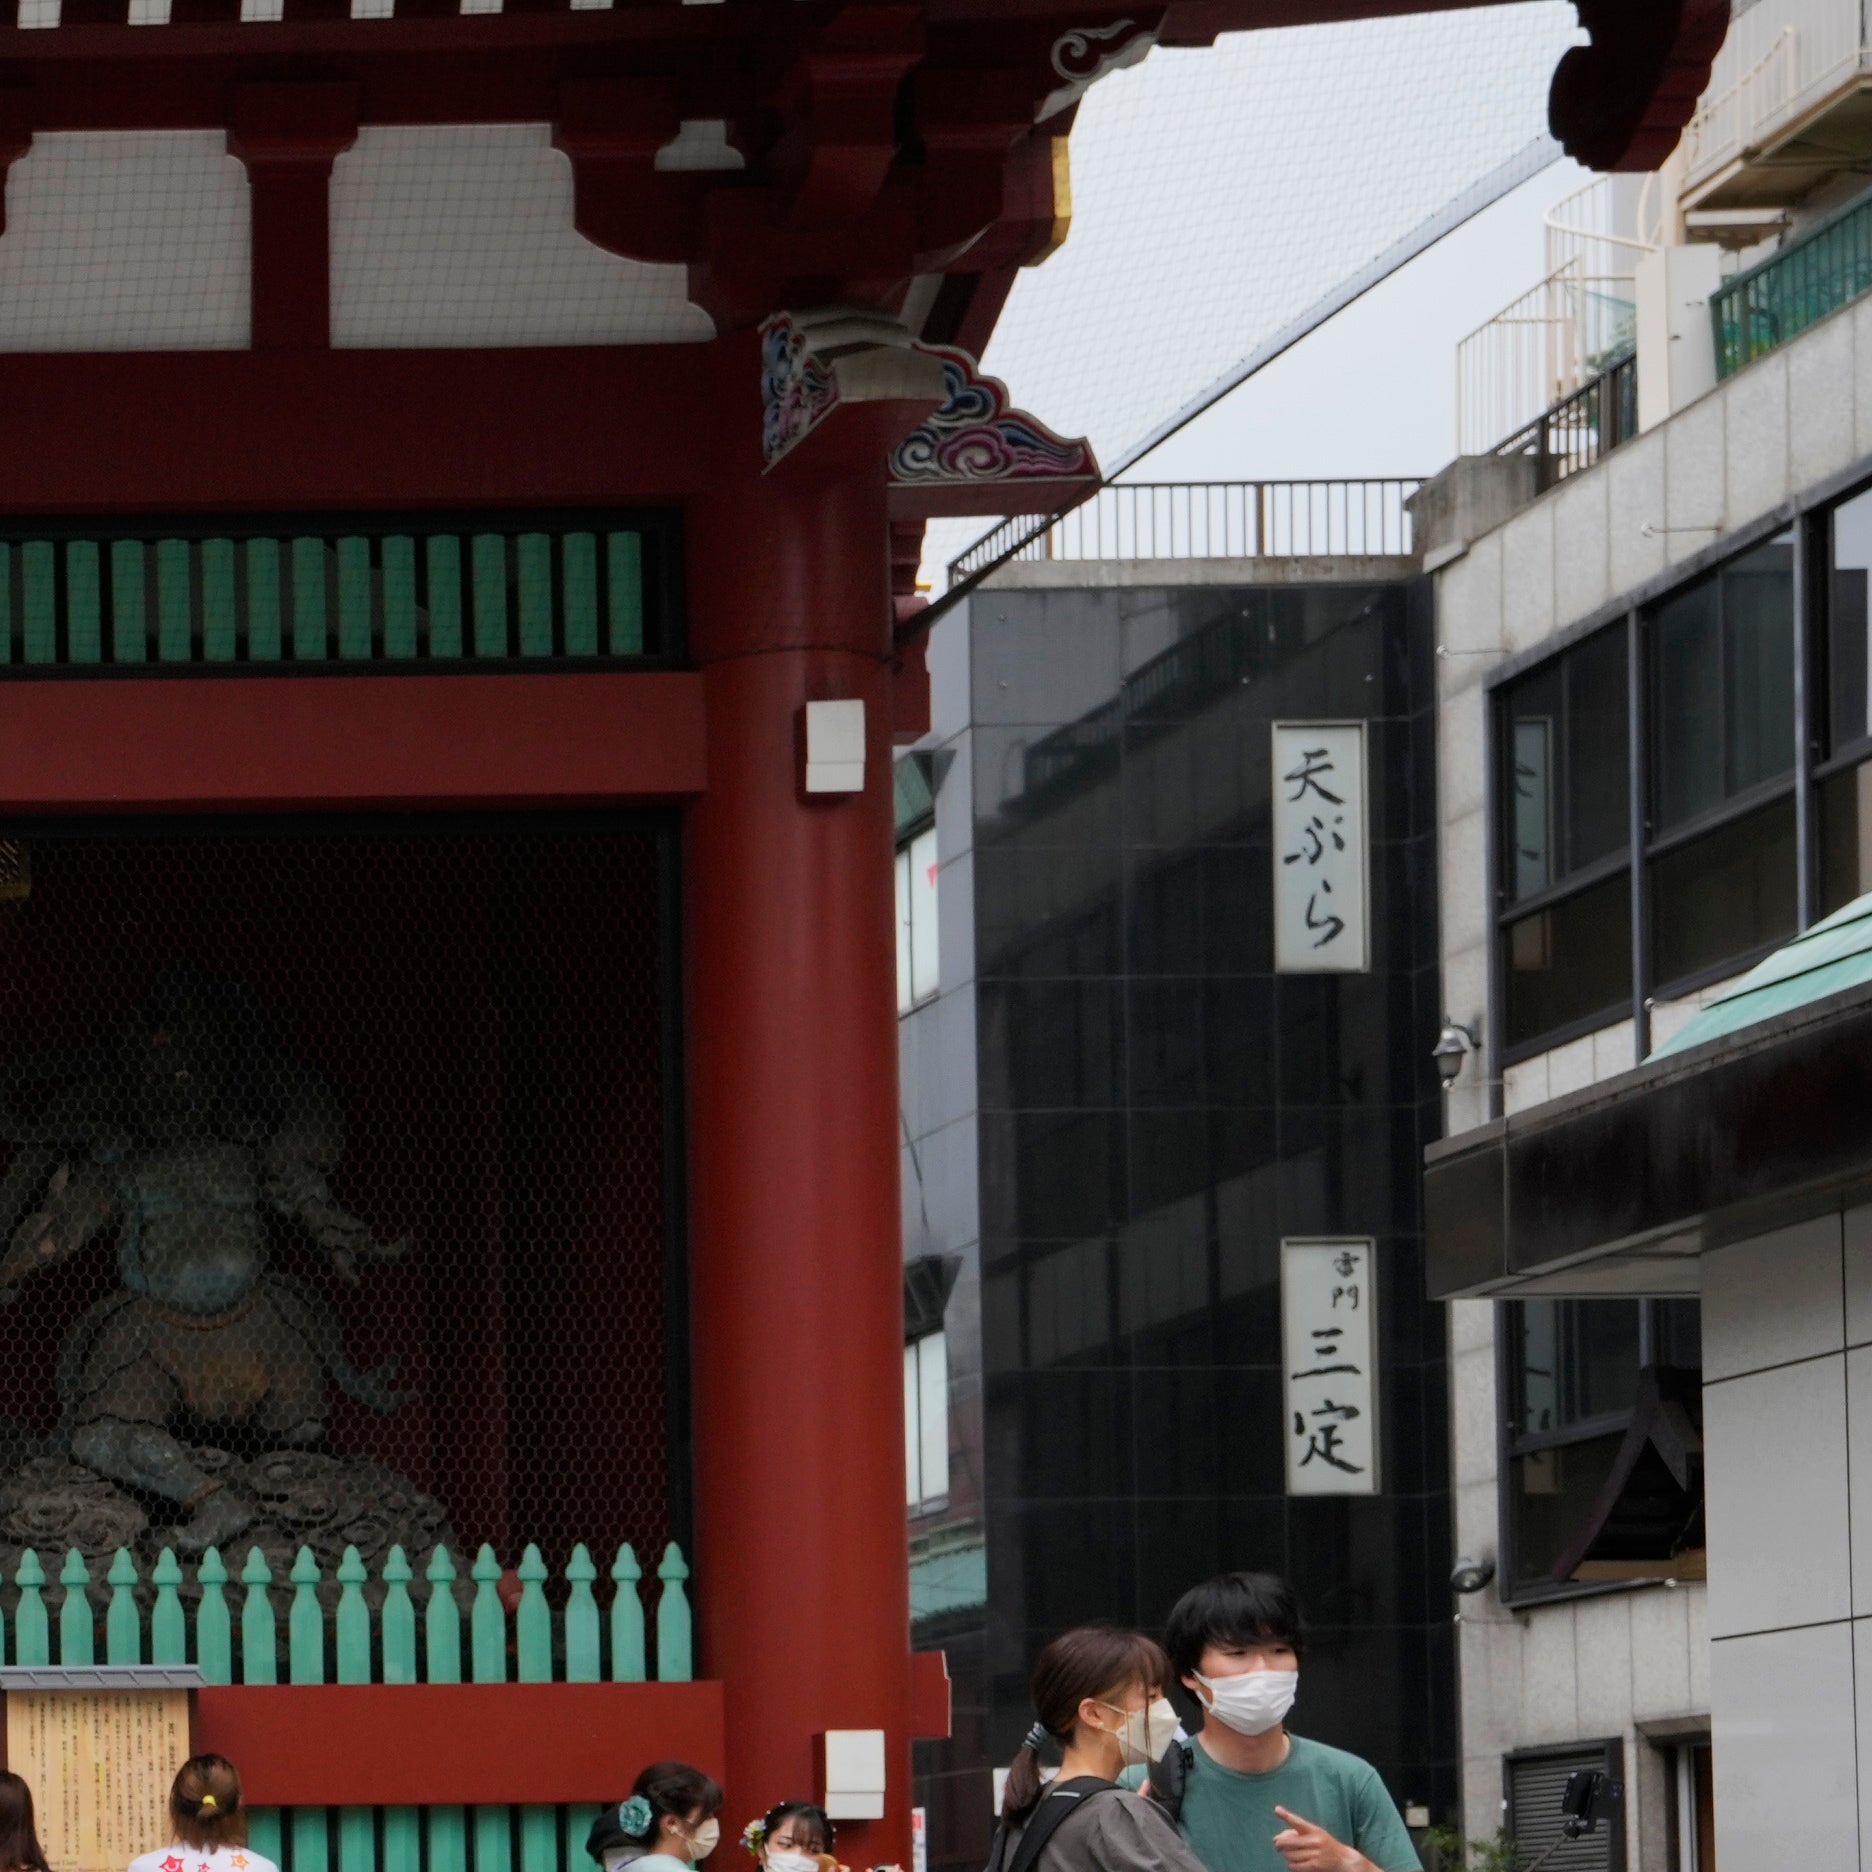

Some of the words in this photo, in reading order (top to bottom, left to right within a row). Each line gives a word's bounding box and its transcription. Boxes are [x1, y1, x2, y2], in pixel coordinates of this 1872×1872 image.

[1284, 748, 1345, 948] 天ぷら
[1291, 1327, 1364, 1475] 三定
